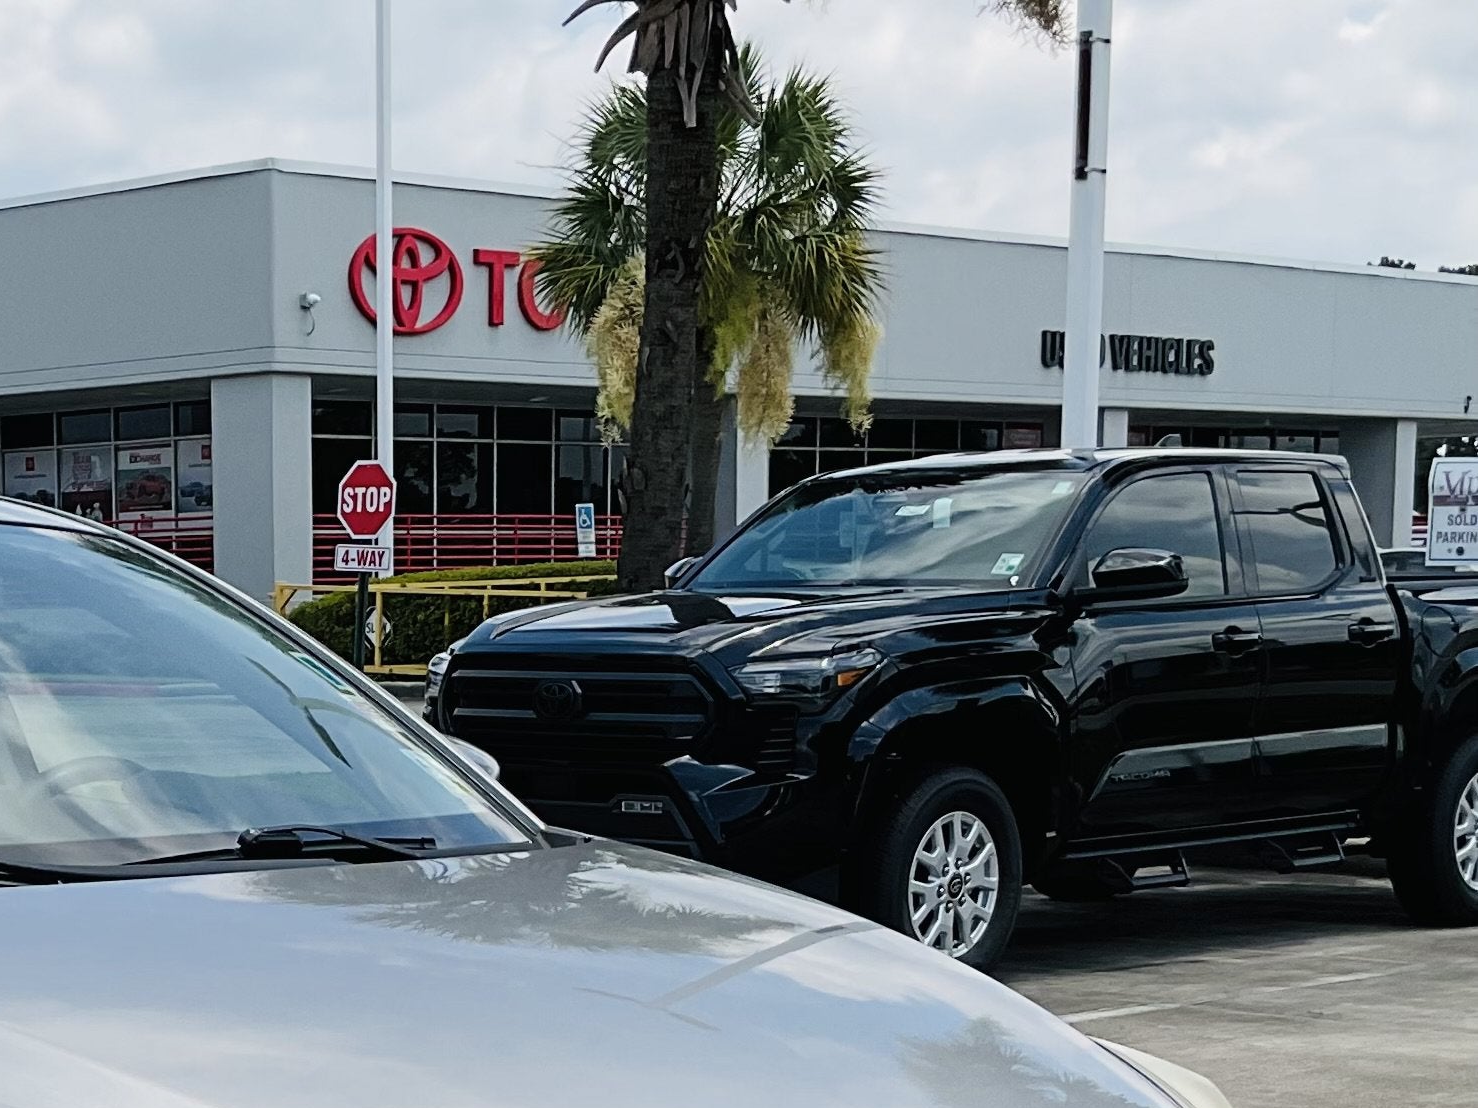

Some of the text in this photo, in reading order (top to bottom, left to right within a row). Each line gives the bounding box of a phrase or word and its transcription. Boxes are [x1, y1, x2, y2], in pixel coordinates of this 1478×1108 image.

[1109, 334, 1214, 375] VEHICLES
[342, 486, 391, 513] STOP
[1447, 514, 1477, 526] SOLD
[1435, 531, 1478, 544] PARKIN
[341, 549, 385, 567] 4-WAY
